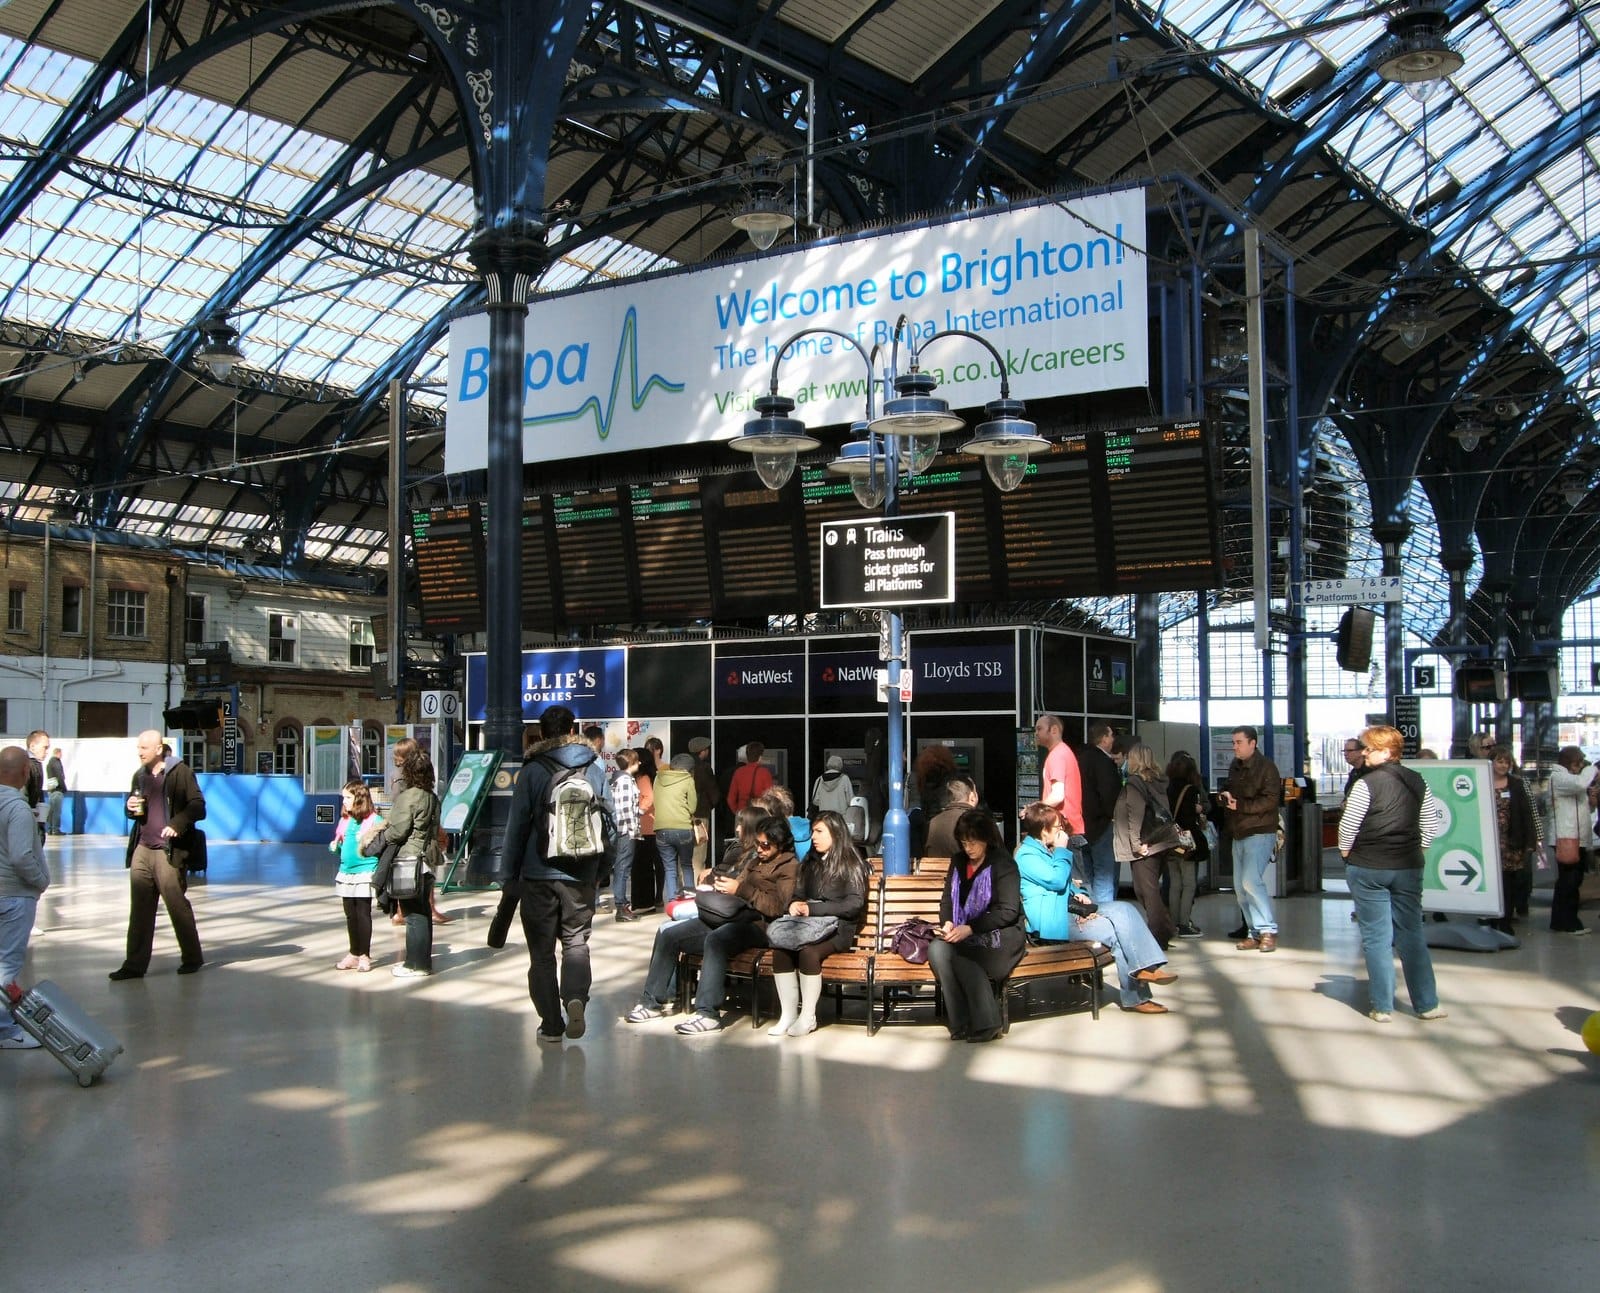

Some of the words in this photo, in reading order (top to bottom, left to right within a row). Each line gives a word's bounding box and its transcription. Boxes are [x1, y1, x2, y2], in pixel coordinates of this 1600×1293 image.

[716, 279, 878, 330] Welcome
[889, 268, 927, 301] to
[941, 223, 1123, 297] Brighton!
[714, 342, 757, 370] The
[765, 336, 833, 362] home
[843, 321, 867, 351] of
[874, 319, 936, 350] Bupa
[946, 279, 1124, 334] International
[458, 342, 590, 406] Bpa
[797, 381, 818, 405] at
[825, 342, 1126, 398] www.a.co.uk/careers
[1174, 421, 1200, 430] Expected
[1061, 434, 1086, 442] Expected
[1105, 447, 1134, 456] Destination
[1106, 467, 1125, 475] Calling
[864, 526, 904, 544] Trains
[864, 547, 885, 561] Pass
[886, 543, 925, 561] through
[864, 562, 892, 577] ticket
[892, 561, 919, 578] gates
[919, 560, 935, 573] for
[864, 579, 876, 592] all
[877, 577, 923, 592] Platforms
[1316, 581, 1323, 590] 5
[1325, 581, 1332, 589] &
[1335, 580, 1343, 589] 6
[1360, 579, 1366, 587] 7
[1369, 578, 1376, 587] &
[1380, 577, 1387, 586] 8
[1316, 594, 1358, 602] Platforms
[1361, 592, 1366, 600] 1
[1368, 592, 1377, 600] to
[526, 668, 597, 690] LLIE'S
[742, 669, 793, 685] NatWest
[837, 666, 879, 682] NatWe
[924, 660, 971, 683] Lloyds
[973, 661, 1003, 677] TSB
[1420, 670, 1430, 686] 5
[523, 691, 573, 702] OOKIES
[225, 703, 231, 715] 2
[1400, 724, 1418, 738] 30
[225, 738, 235, 749] 30
